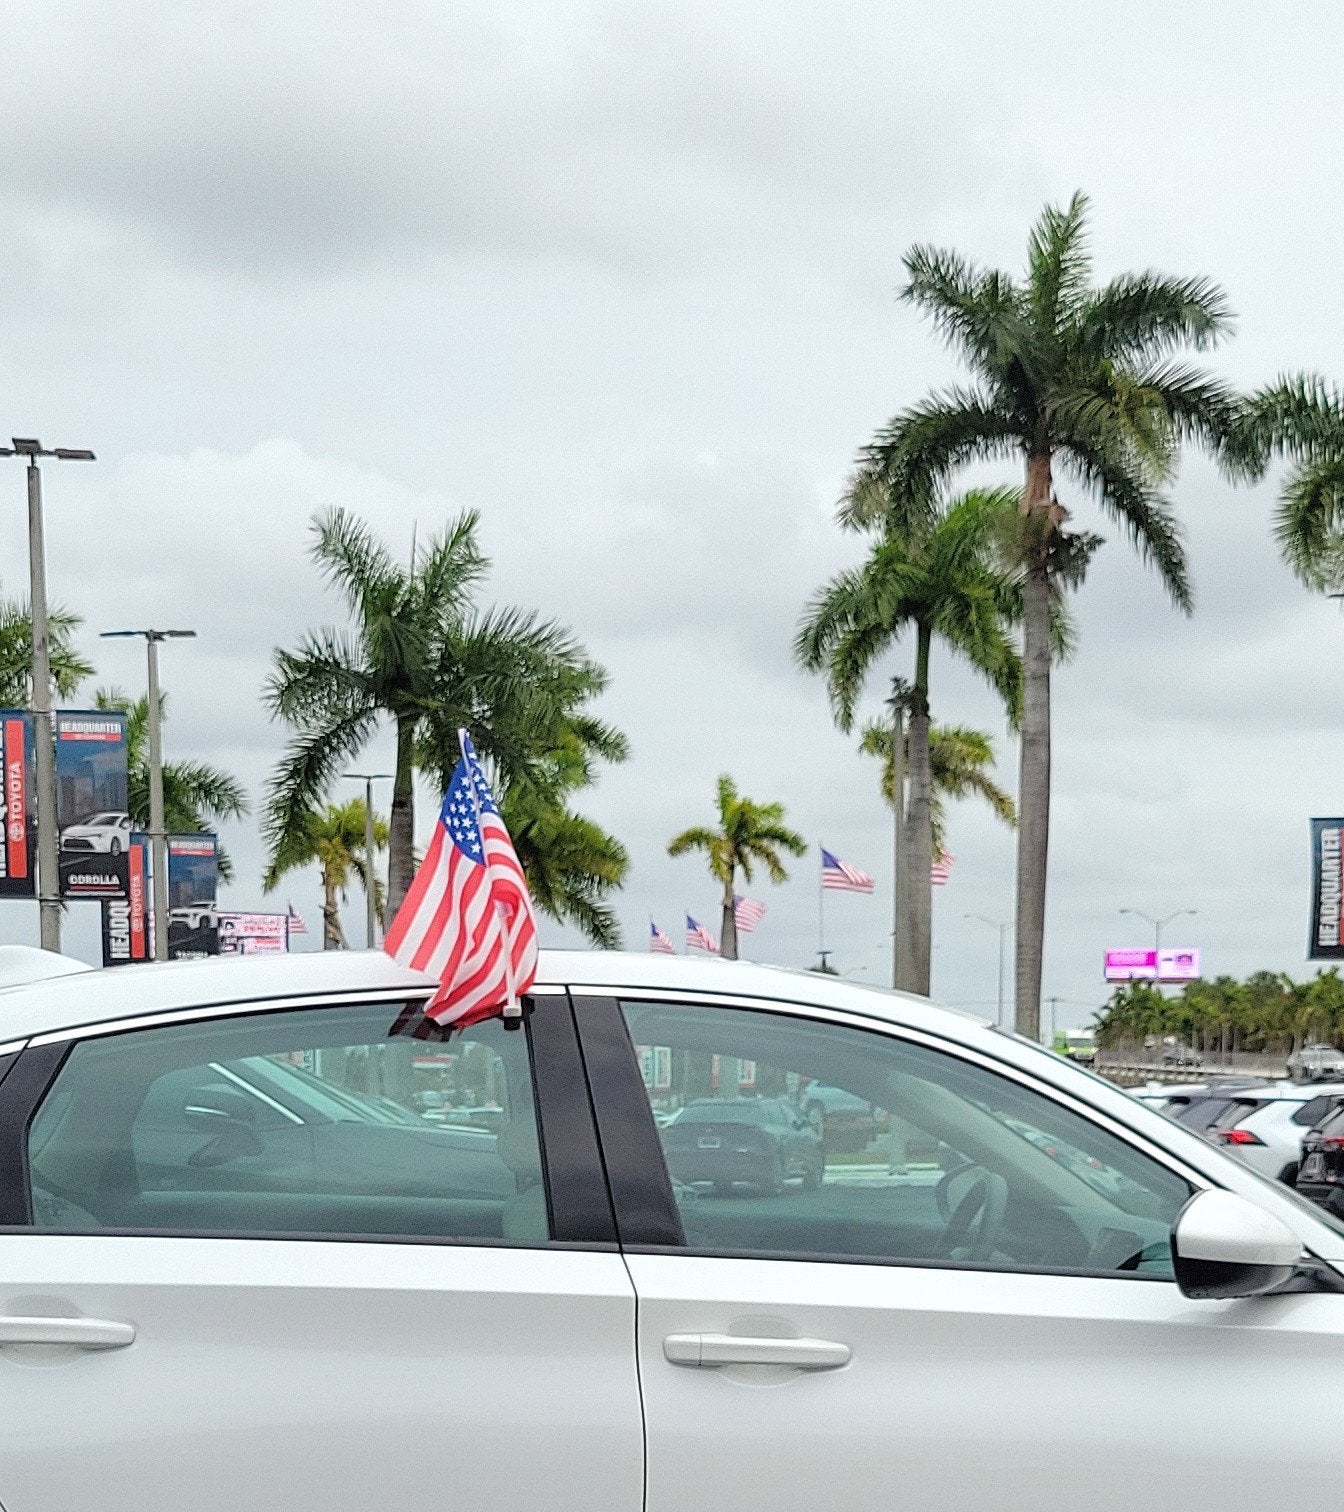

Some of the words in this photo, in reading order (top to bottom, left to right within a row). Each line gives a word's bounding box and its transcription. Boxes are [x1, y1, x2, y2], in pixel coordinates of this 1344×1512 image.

[9, 762, 24, 820] TOYOTA
[68, 874, 120, 885] COROLLA
[1318, 828, 1341, 946] HEADQUARTER
